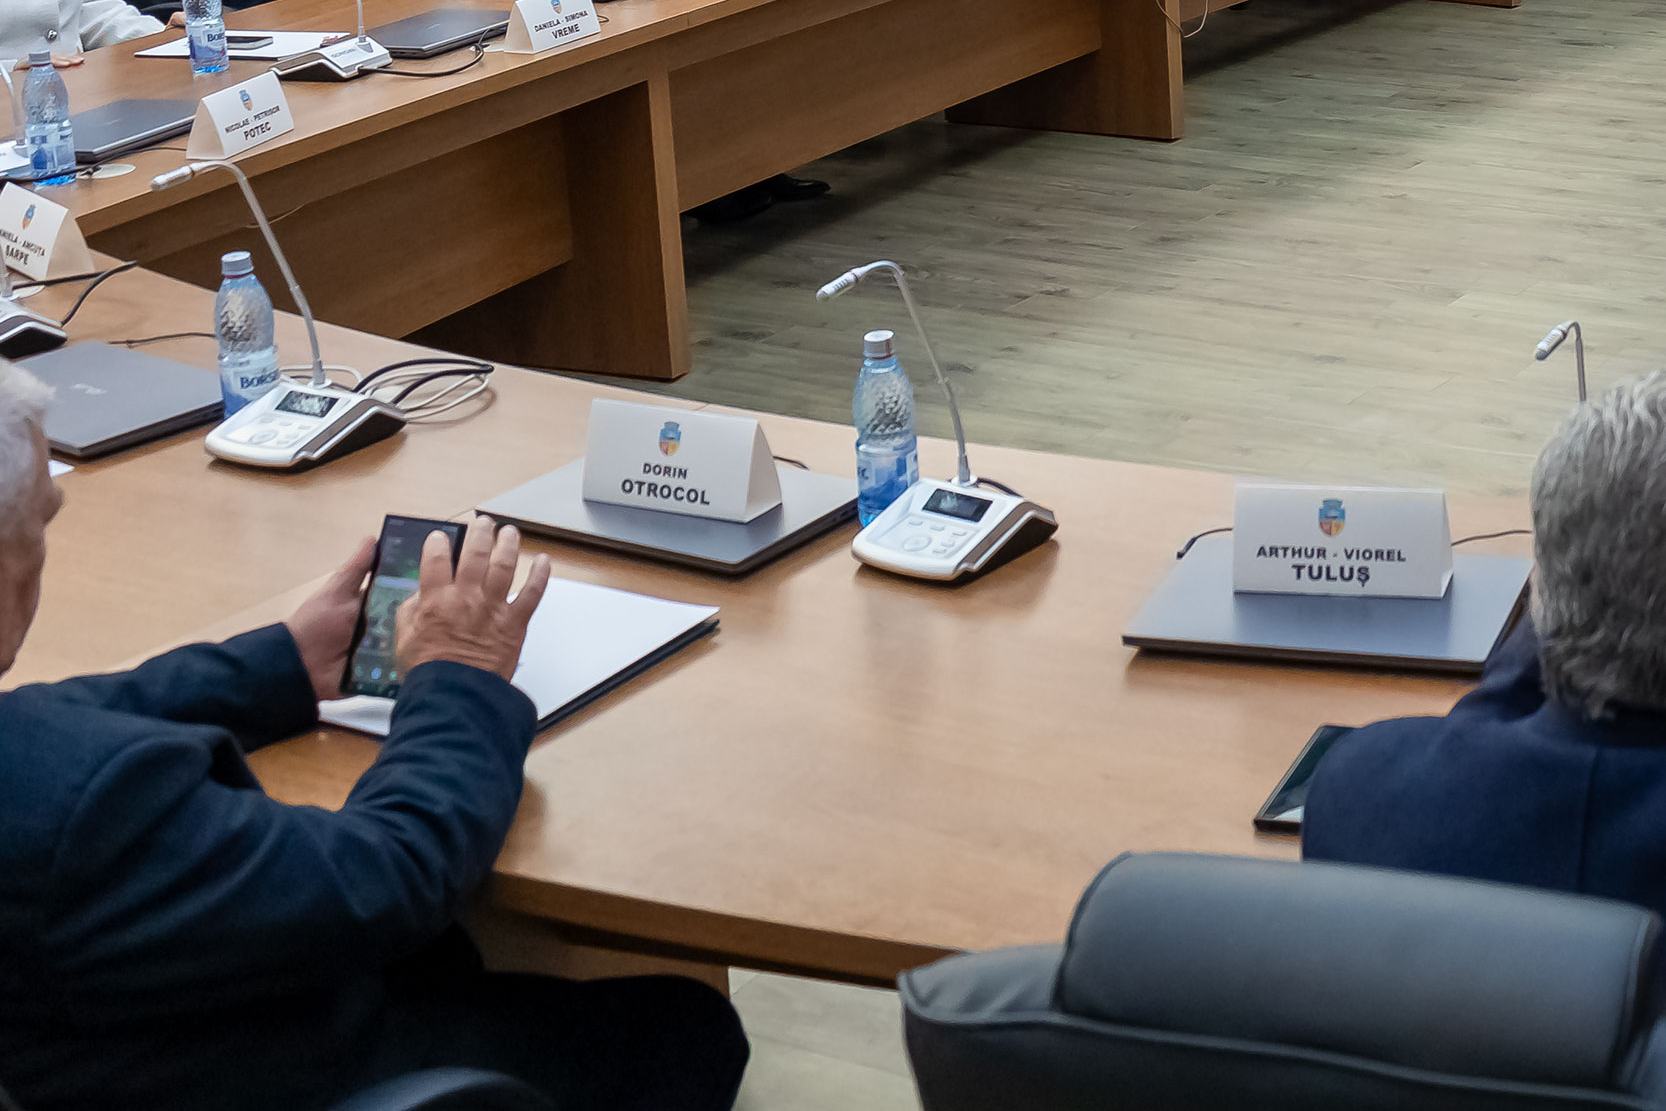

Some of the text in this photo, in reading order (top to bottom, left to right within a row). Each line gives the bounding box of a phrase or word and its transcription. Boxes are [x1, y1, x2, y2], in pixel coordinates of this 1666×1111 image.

[534, 19, 560, 32] DANIELA
[565, 10, 588, 23] SIMONA
[552, 23, 580, 39] VREME
[225, 118, 250, 134] NICOLAE
[244, 122, 271, 140] POTEC
[643, 463, 688, 479] DORIN
[621, 479, 710, 505] OTROCOL
[1256, 545, 1327, 559] ARTHUR
[1344, 548, 1406, 562] VIOREL
[1292, 564, 1370, 587] TULUȘ
